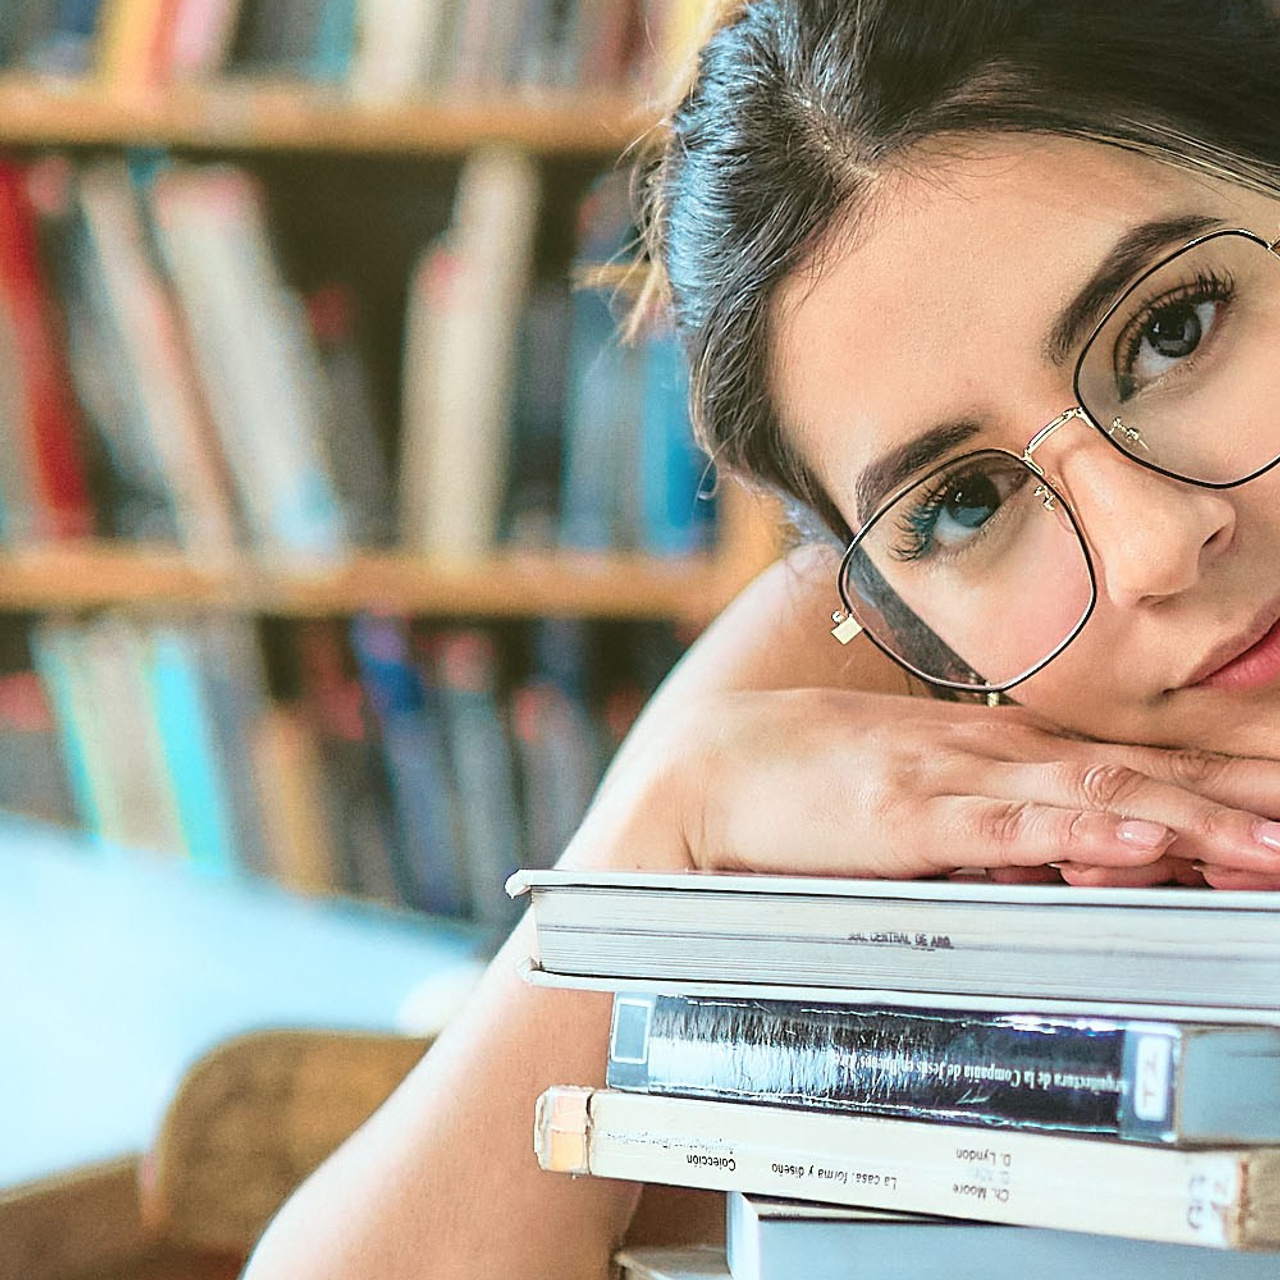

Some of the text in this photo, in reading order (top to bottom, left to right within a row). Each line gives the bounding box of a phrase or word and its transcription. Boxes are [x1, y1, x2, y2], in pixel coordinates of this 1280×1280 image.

[870, 932, 911, 945] CENTRAL
[915, 932, 928, 946] DE
[947, 1063, 962, 1082] de
[963, 1063, 1021, 1089] Compañía
[1024, 1070, 1035, 1090] la
[1037, 1071, 1051, 1090] de
[686, 1154, 737, 1173] Colección
[955, 1148, 996, 1166] Lyndon
[771, 1162, 805, 1179] diseño
[806, 1164, 814, 1177] y
[817, 1168, 848, 1185] forma
[884, 1175, 897, 1191] La
[952, 1184, 987, 1200] Moore
